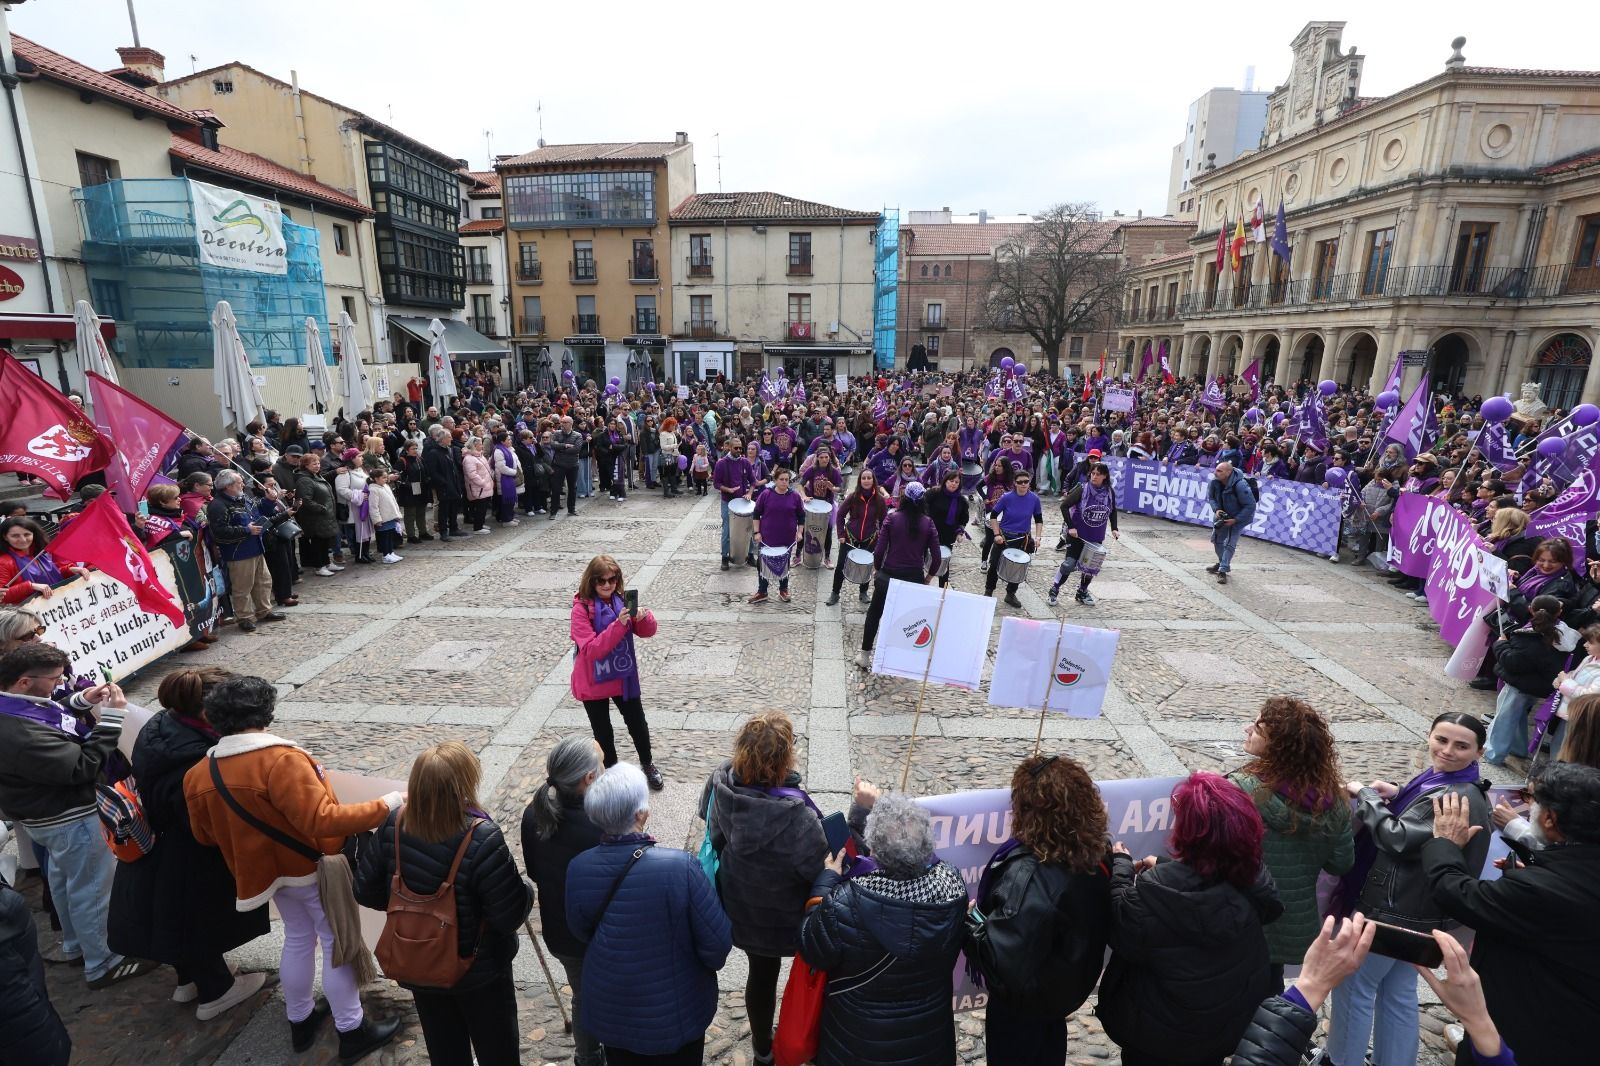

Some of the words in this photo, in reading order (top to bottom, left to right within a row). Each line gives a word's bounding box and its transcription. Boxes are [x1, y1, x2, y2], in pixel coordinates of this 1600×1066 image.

[202, 229, 284, 257] Decolesa
[1138, 491, 1181, 516] POR
[1185, 500, 1215, 522] LA
[37, 594, 83, 627] rraka
[103, 581, 119, 598] de
[82, 639, 98, 655] de
[99, 629, 113, 645] la
[115, 611, 150, 632] lucha
[903, 618, 927, 633] Palestina
[114, 649, 129, 664] la
[1061, 657, 1086, 673] Palestina
